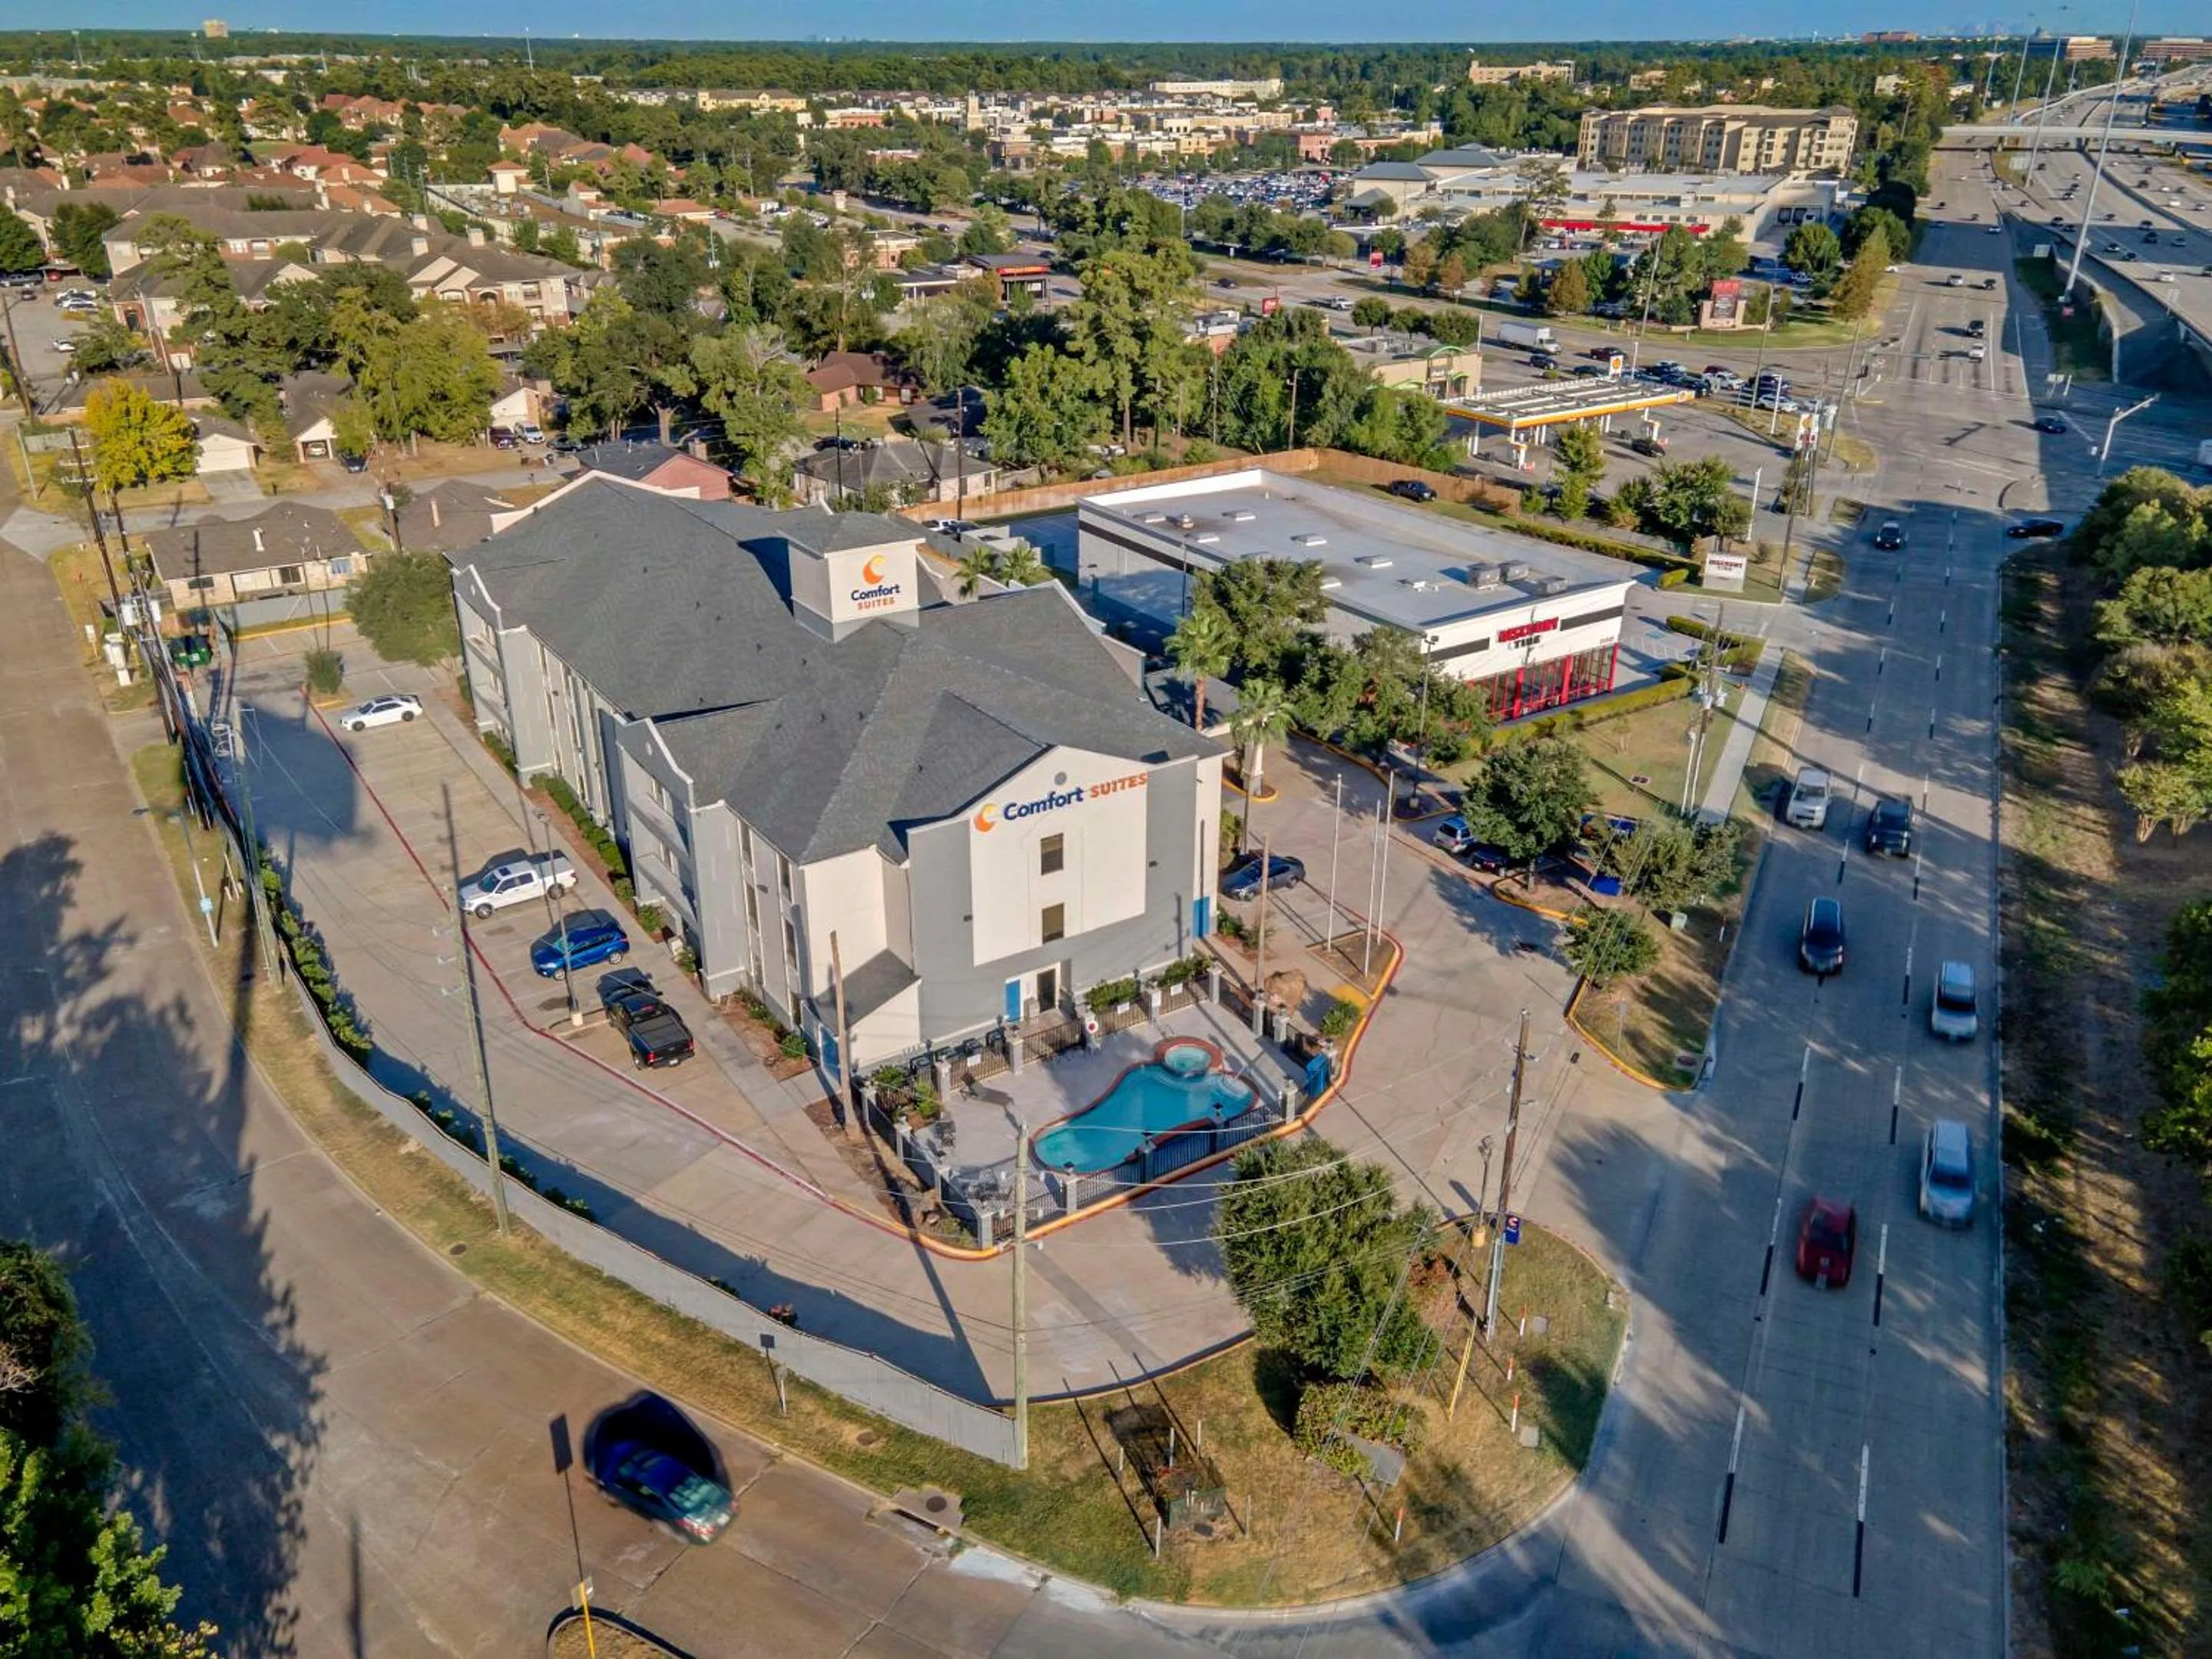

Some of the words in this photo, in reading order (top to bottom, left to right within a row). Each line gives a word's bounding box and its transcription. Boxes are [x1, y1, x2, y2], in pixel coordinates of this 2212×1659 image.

[851, 584, 900, 601] Comfort
[857, 597, 896, 611] SUITES
[1003, 786, 1084, 820] Comfort
[1090, 772, 1147, 798] SUITES
